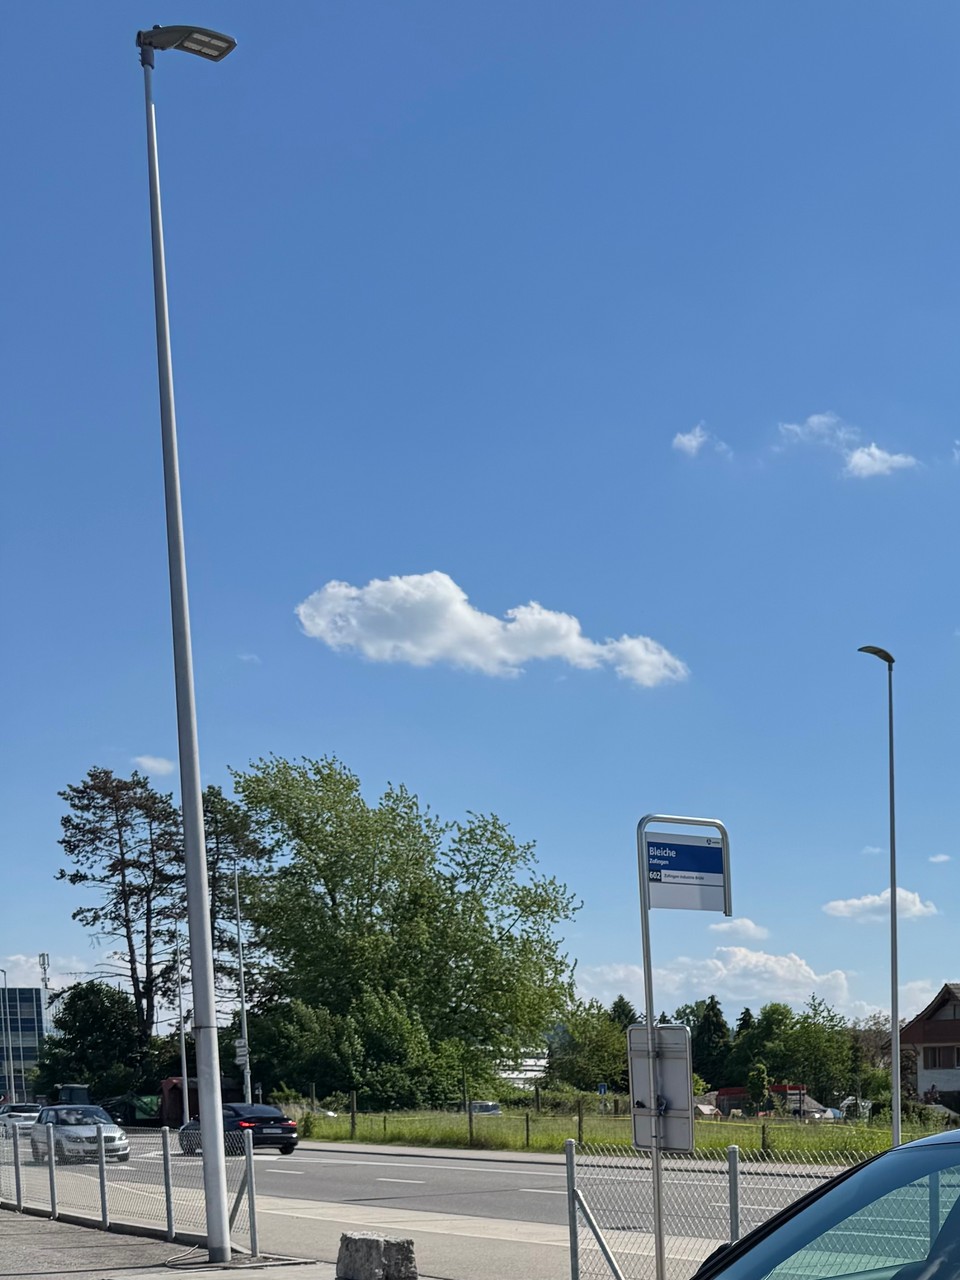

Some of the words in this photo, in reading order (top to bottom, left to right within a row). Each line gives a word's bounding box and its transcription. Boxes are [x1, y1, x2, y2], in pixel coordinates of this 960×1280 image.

[649, 847, 676, 857] Bleiche
[649, 858, 669, 866] Zofingen
[649, 871, 661, 879] 602
